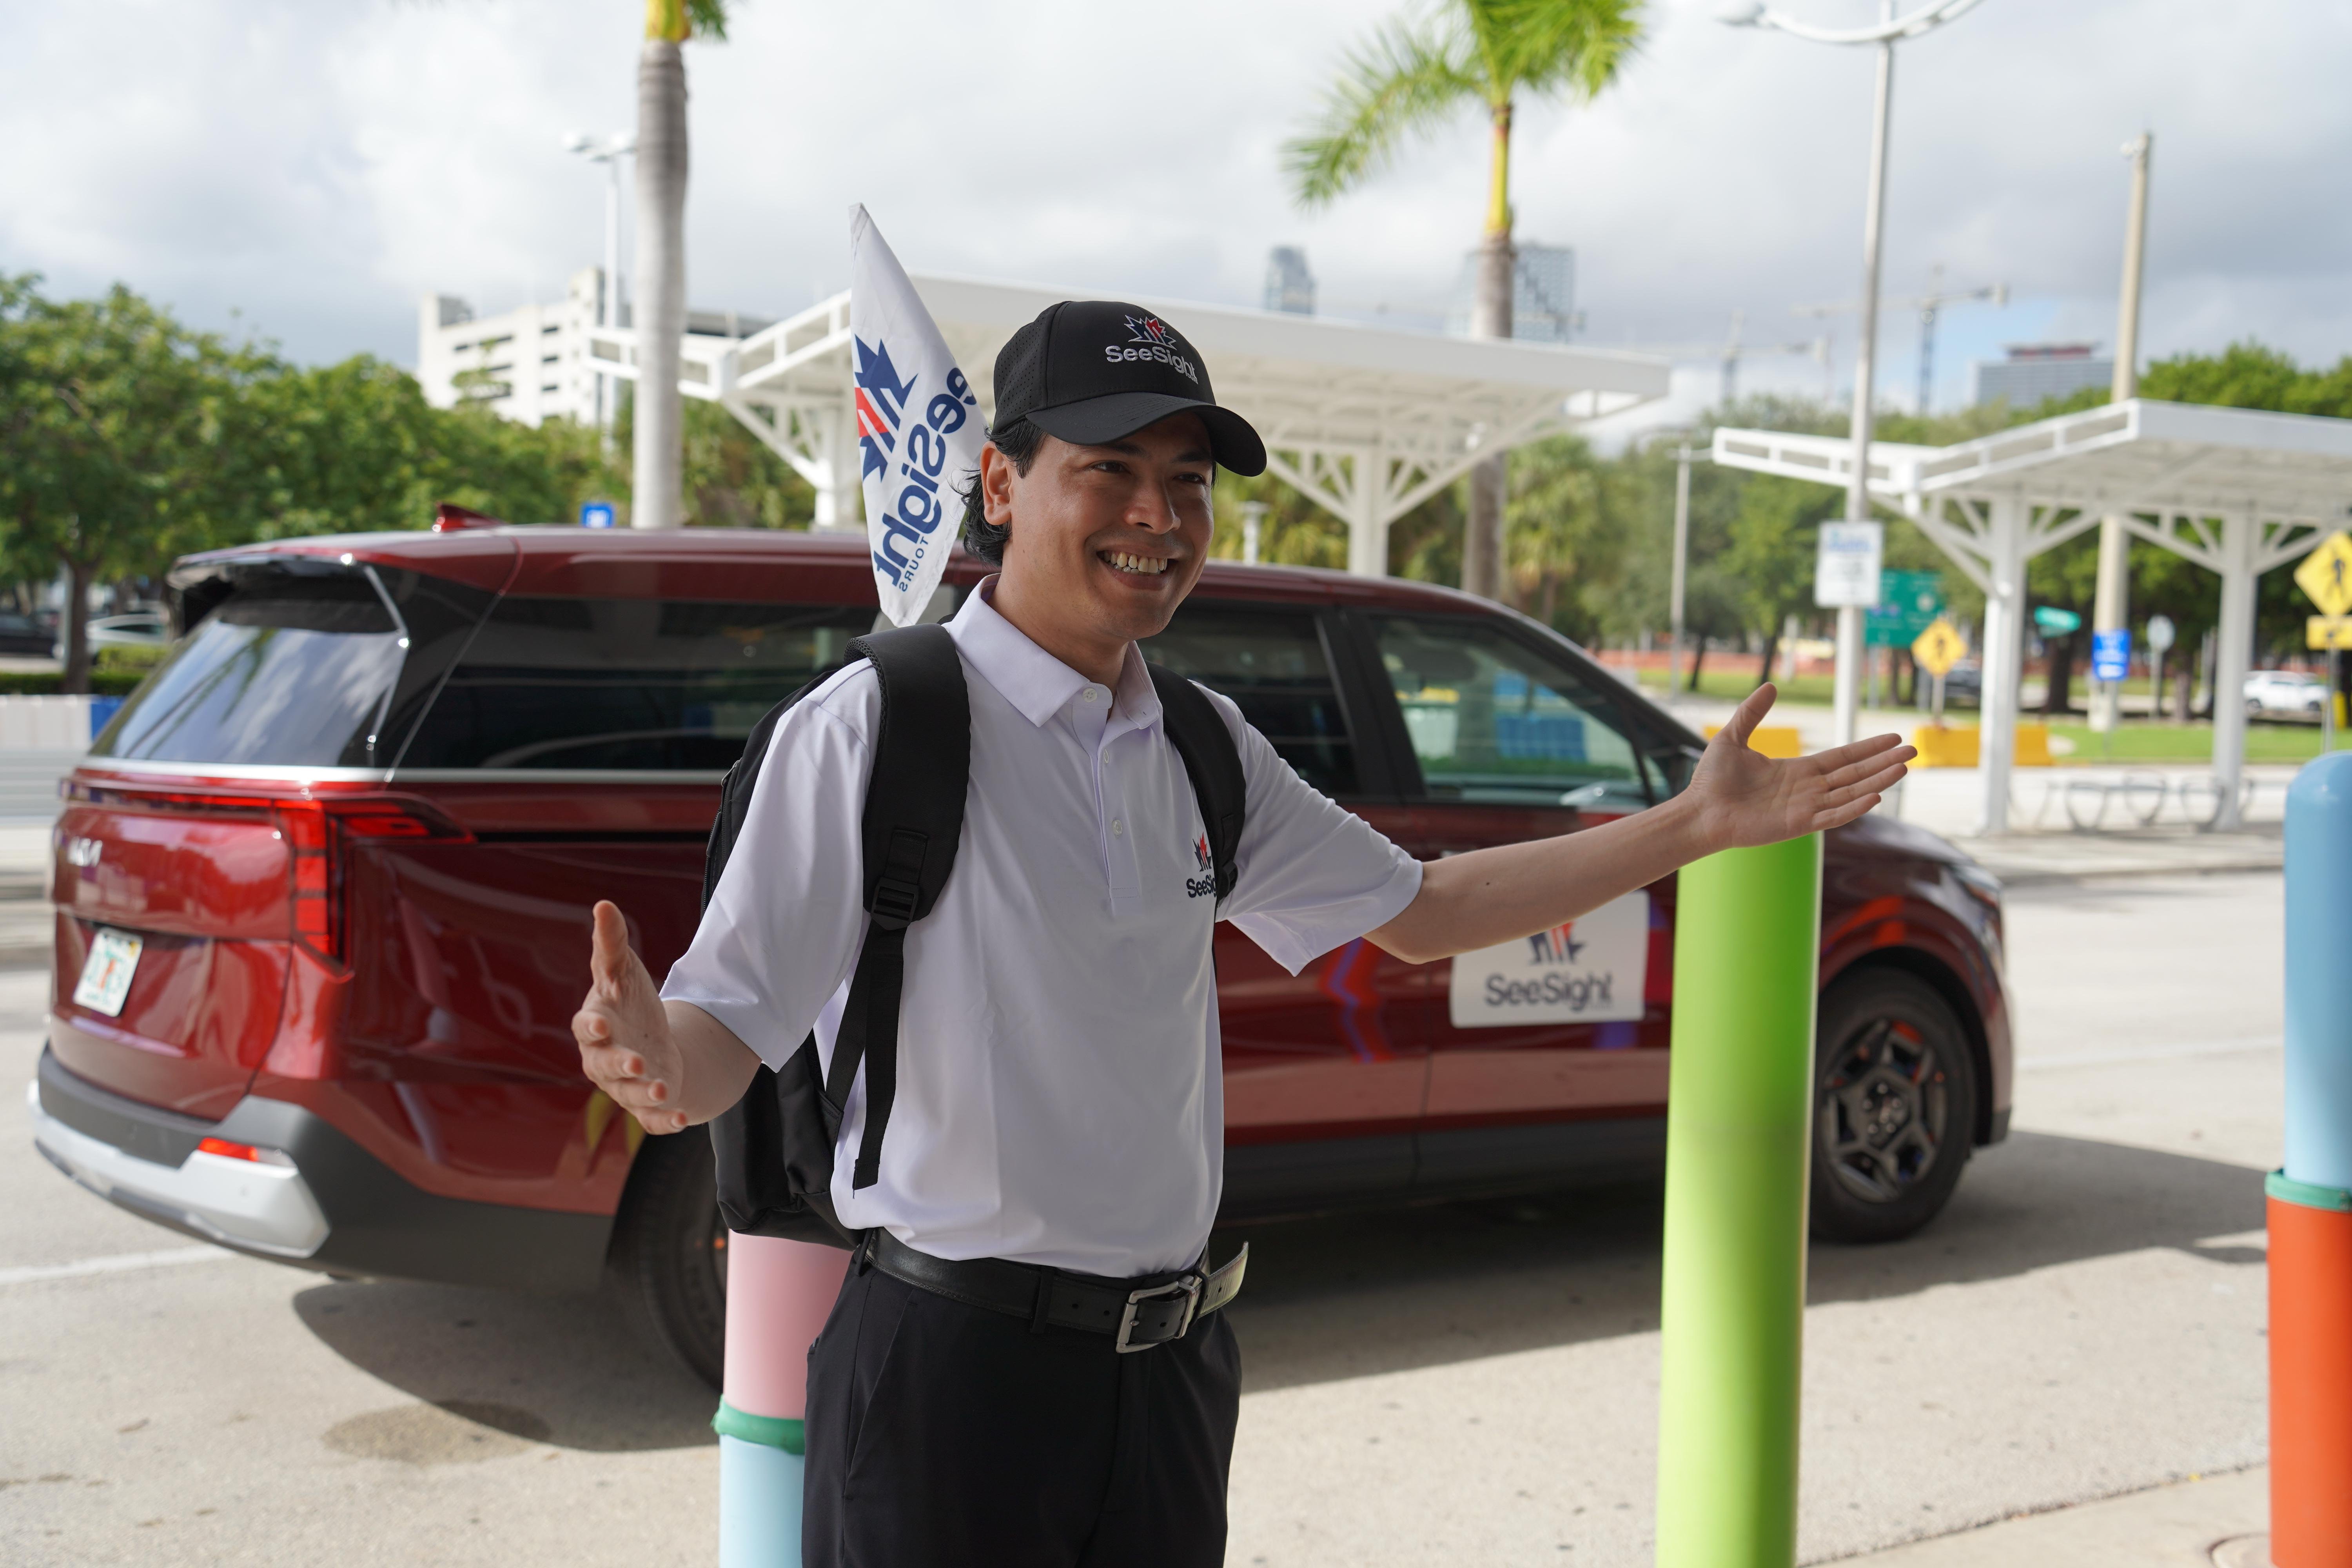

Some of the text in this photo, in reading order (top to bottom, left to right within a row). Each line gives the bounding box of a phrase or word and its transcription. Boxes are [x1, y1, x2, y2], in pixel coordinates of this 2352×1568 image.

[1105, 345, 1195, 377] SeeSight
[1186, 874, 1217, 898] SeeSig
[1485, 973, 1612, 1011] SeeSight
